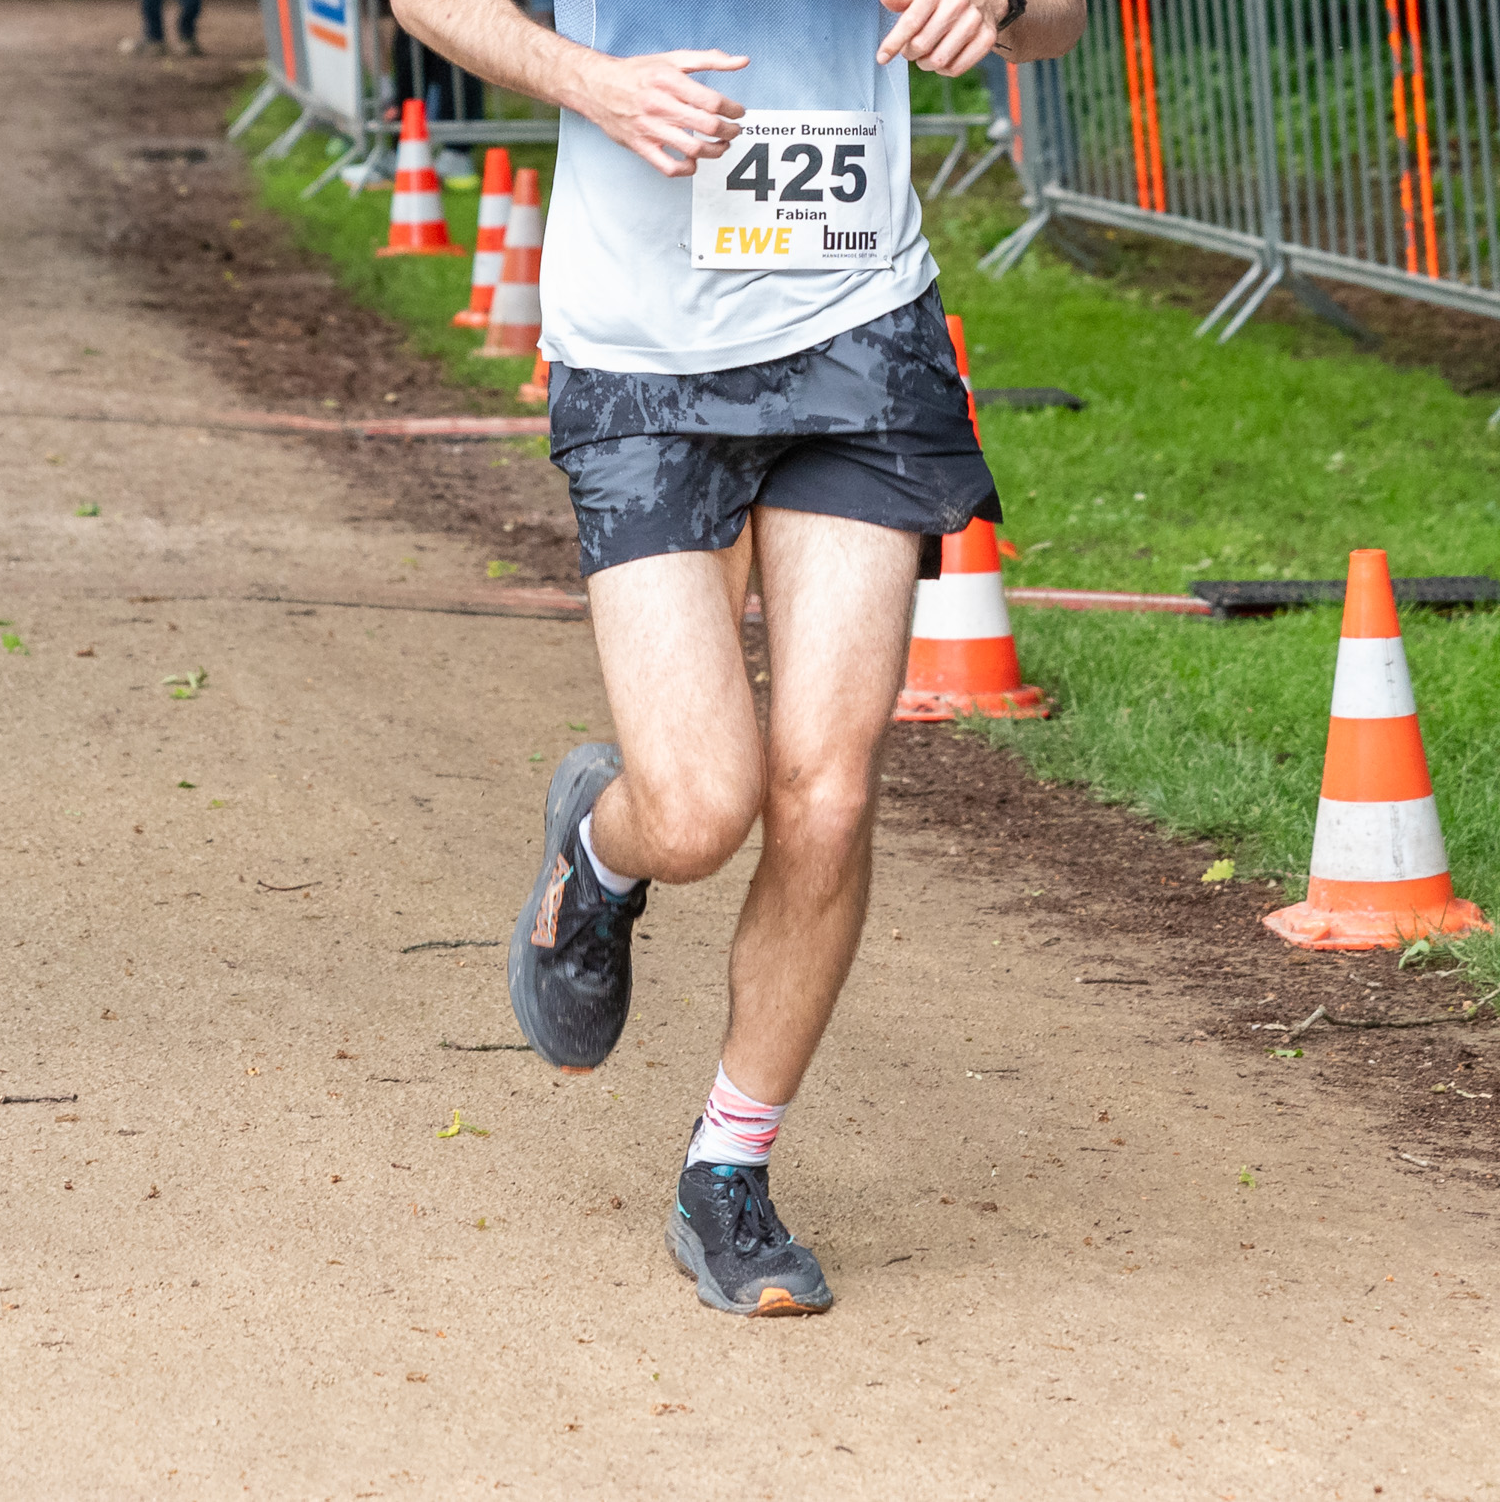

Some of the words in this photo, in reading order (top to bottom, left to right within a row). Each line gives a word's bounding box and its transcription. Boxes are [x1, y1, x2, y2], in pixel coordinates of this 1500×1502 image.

[740, 124, 796, 136] rstener
[801, 124, 877, 137] Brunnenlauf
[726, 143, 867, 203] 425
[776, 208, 827, 220] Fabian
[714, 226, 792, 254] EWE
[823, 225, 878, 250] bruns
